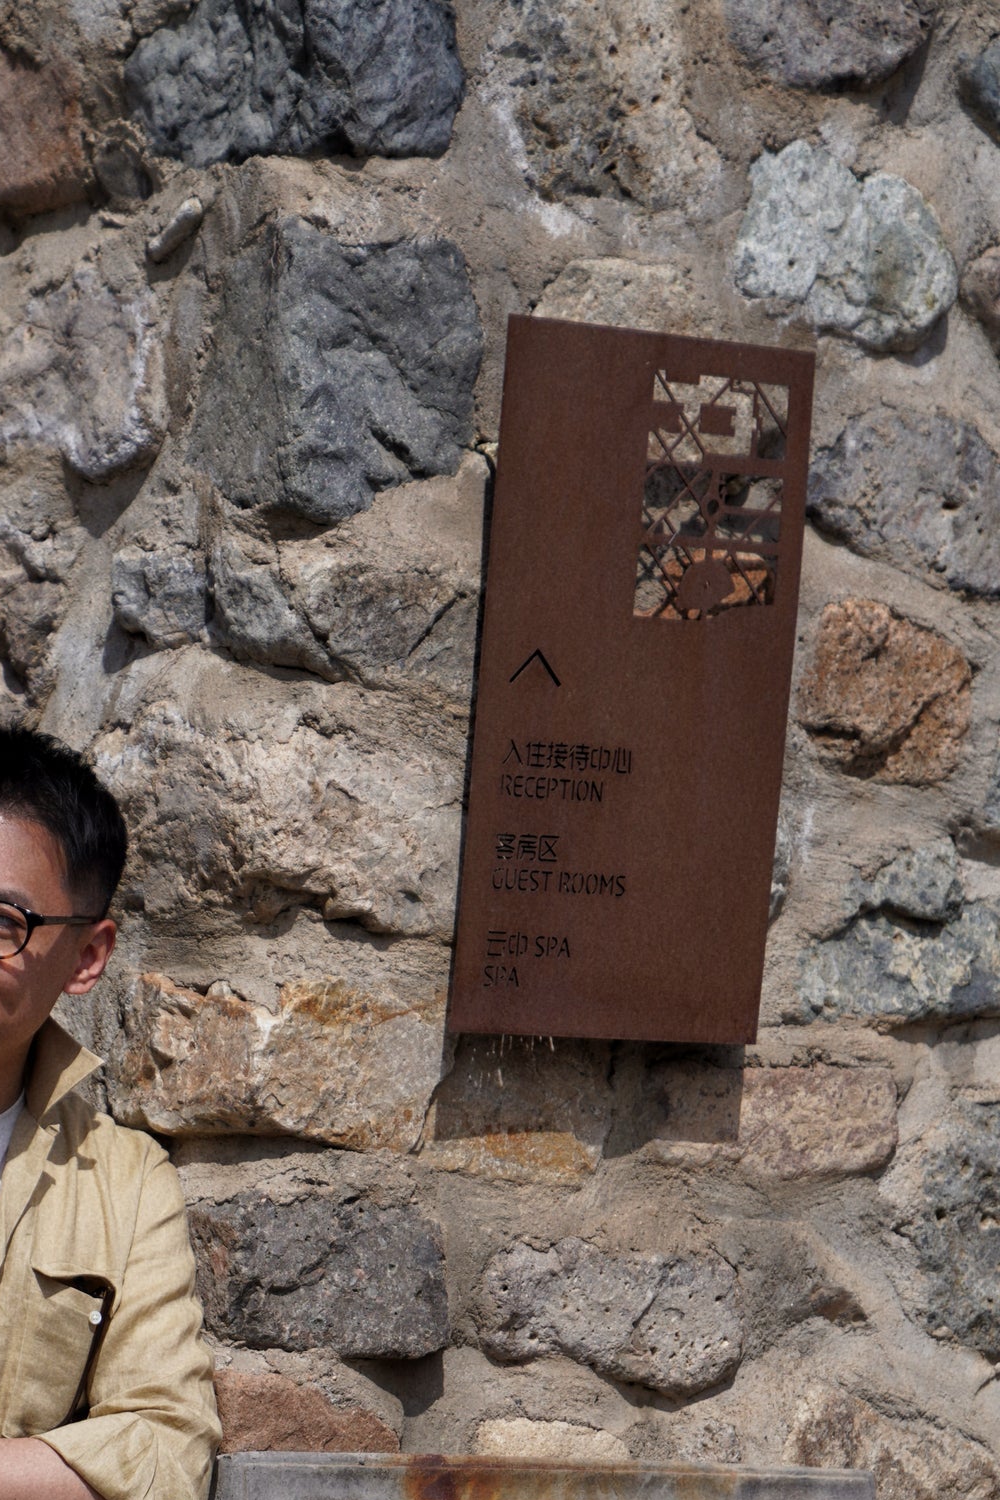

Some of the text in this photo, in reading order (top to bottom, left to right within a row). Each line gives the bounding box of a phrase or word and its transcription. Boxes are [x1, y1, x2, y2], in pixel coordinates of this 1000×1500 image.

[502, 739, 632, 774] 入住接待中心
[501, 774, 603, 802] RECEPTION
[495, 832, 560, 862] 客房区
[492, 867, 626, 897] GUEST ROOMS
[534, 935, 570, 958] SPA
[483, 965, 519, 988] SPA
